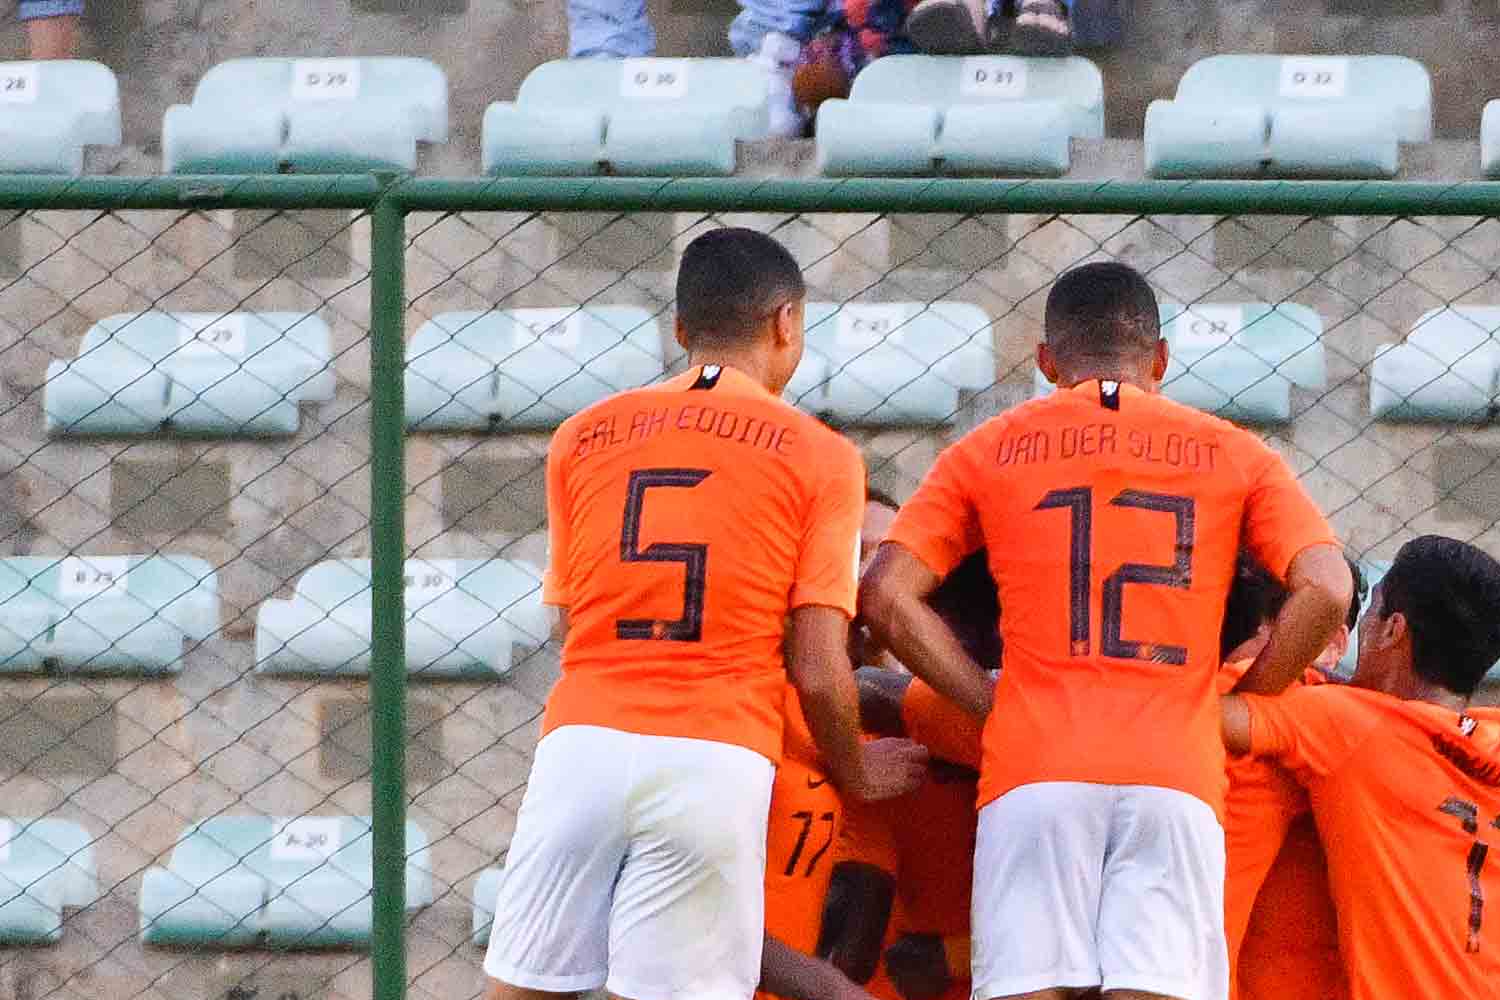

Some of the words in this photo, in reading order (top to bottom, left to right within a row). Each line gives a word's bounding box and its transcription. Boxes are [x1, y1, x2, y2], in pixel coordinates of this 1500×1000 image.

[975, 68, 988, 83] D
[677, 405, 799, 451] EDDINE
[996, 429, 1049, 466] VAN
[1060, 423, 1117, 459] DER
[1128, 429, 1220, 469] SLOOT
[616, 468, 713, 641] 5
[1033, 486, 1195, 665] 12
